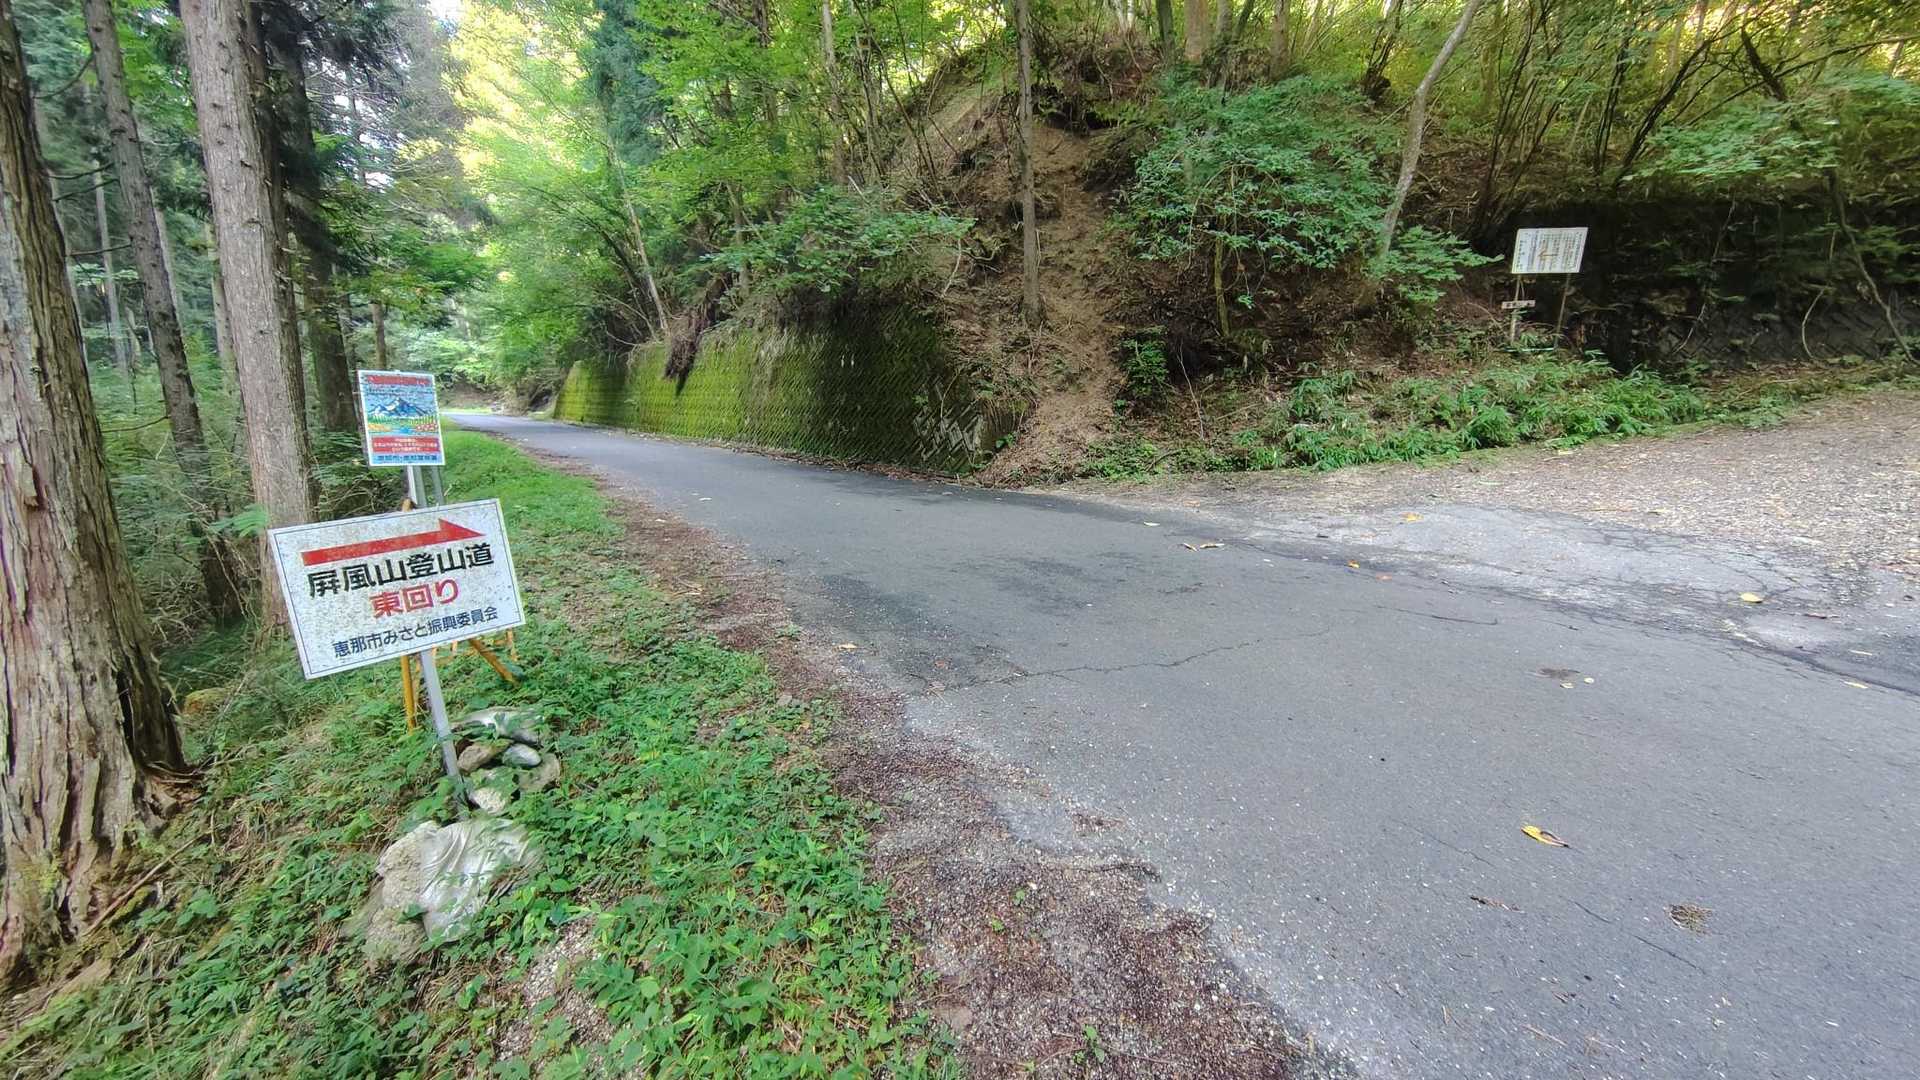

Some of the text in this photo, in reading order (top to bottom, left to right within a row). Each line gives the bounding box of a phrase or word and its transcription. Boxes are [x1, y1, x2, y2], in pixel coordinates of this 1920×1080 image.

[307, 542, 494, 598] 屏風山登山道
[369, 579, 459, 619] 東回り
[332, 606, 498, 658] 恵那市みさと振興委員会
